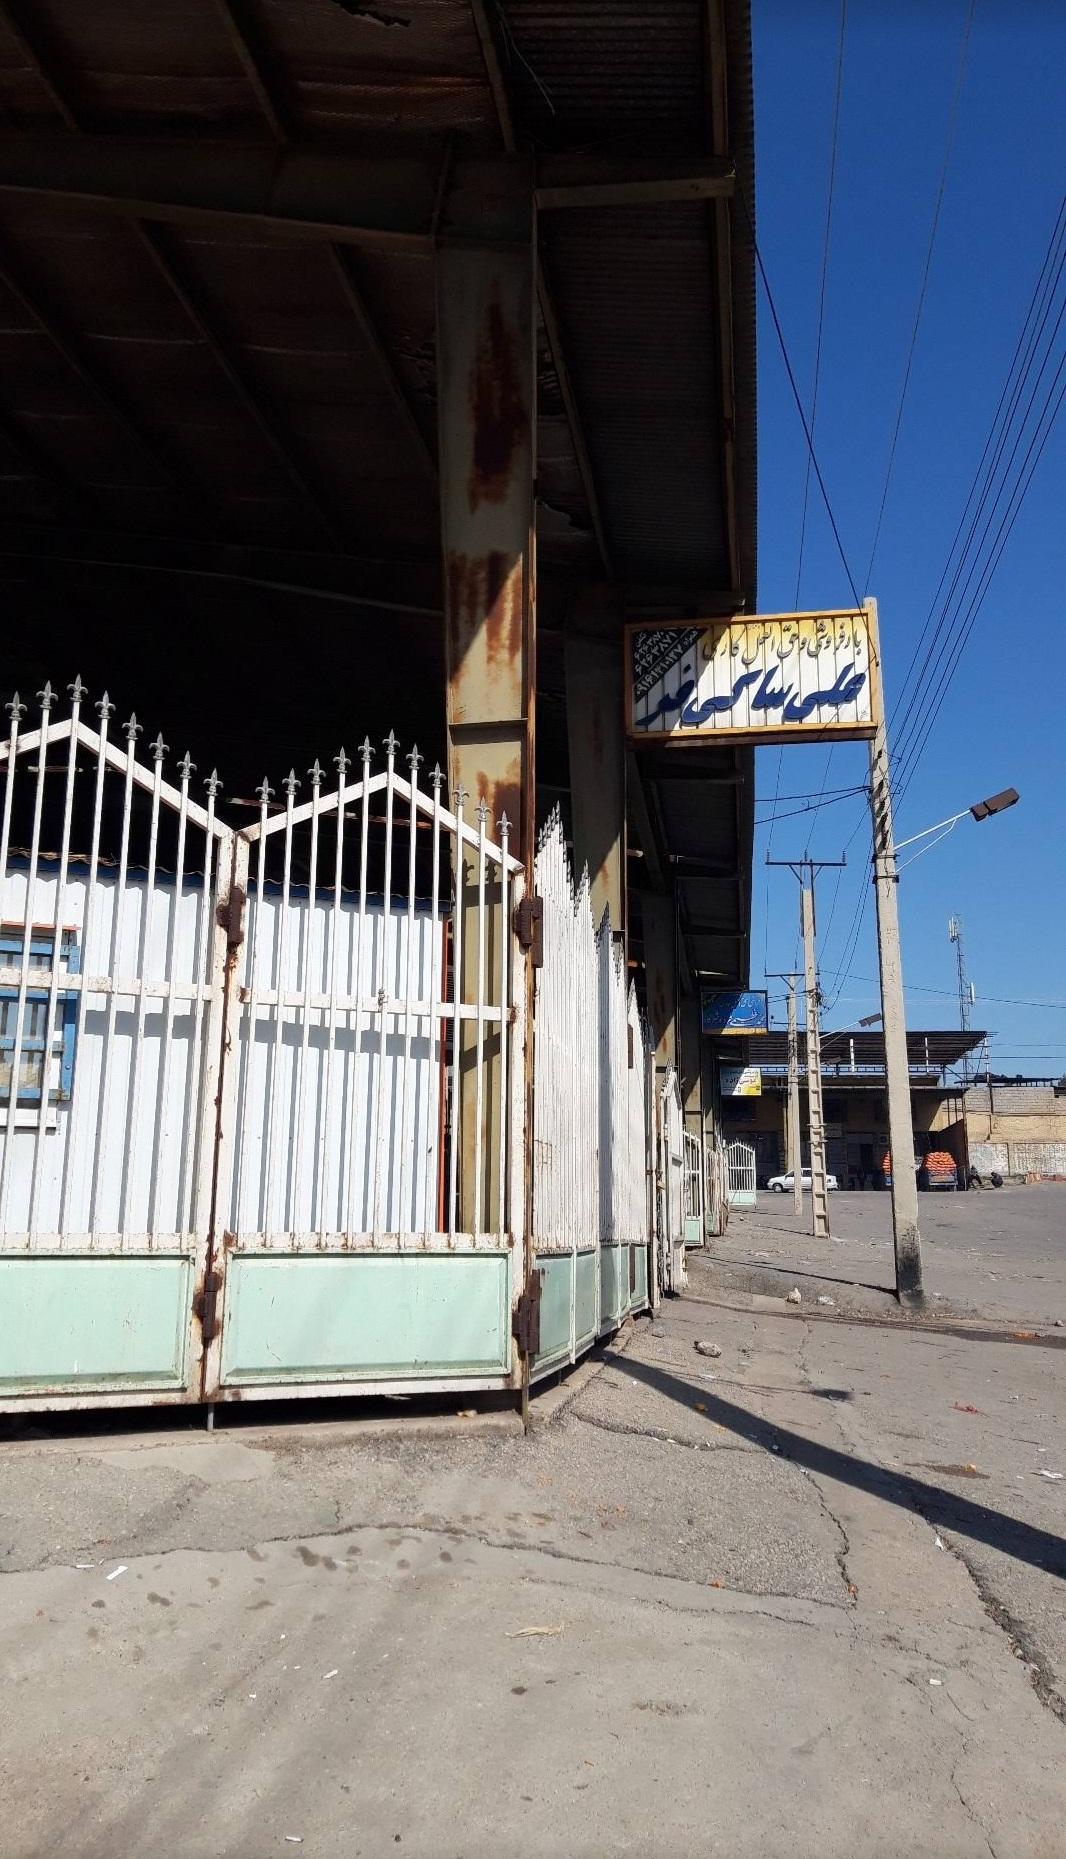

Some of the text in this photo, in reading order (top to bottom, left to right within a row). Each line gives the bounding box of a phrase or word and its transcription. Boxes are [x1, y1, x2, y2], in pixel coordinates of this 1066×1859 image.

[635, 662, 867, 727] علی ساکی فر
